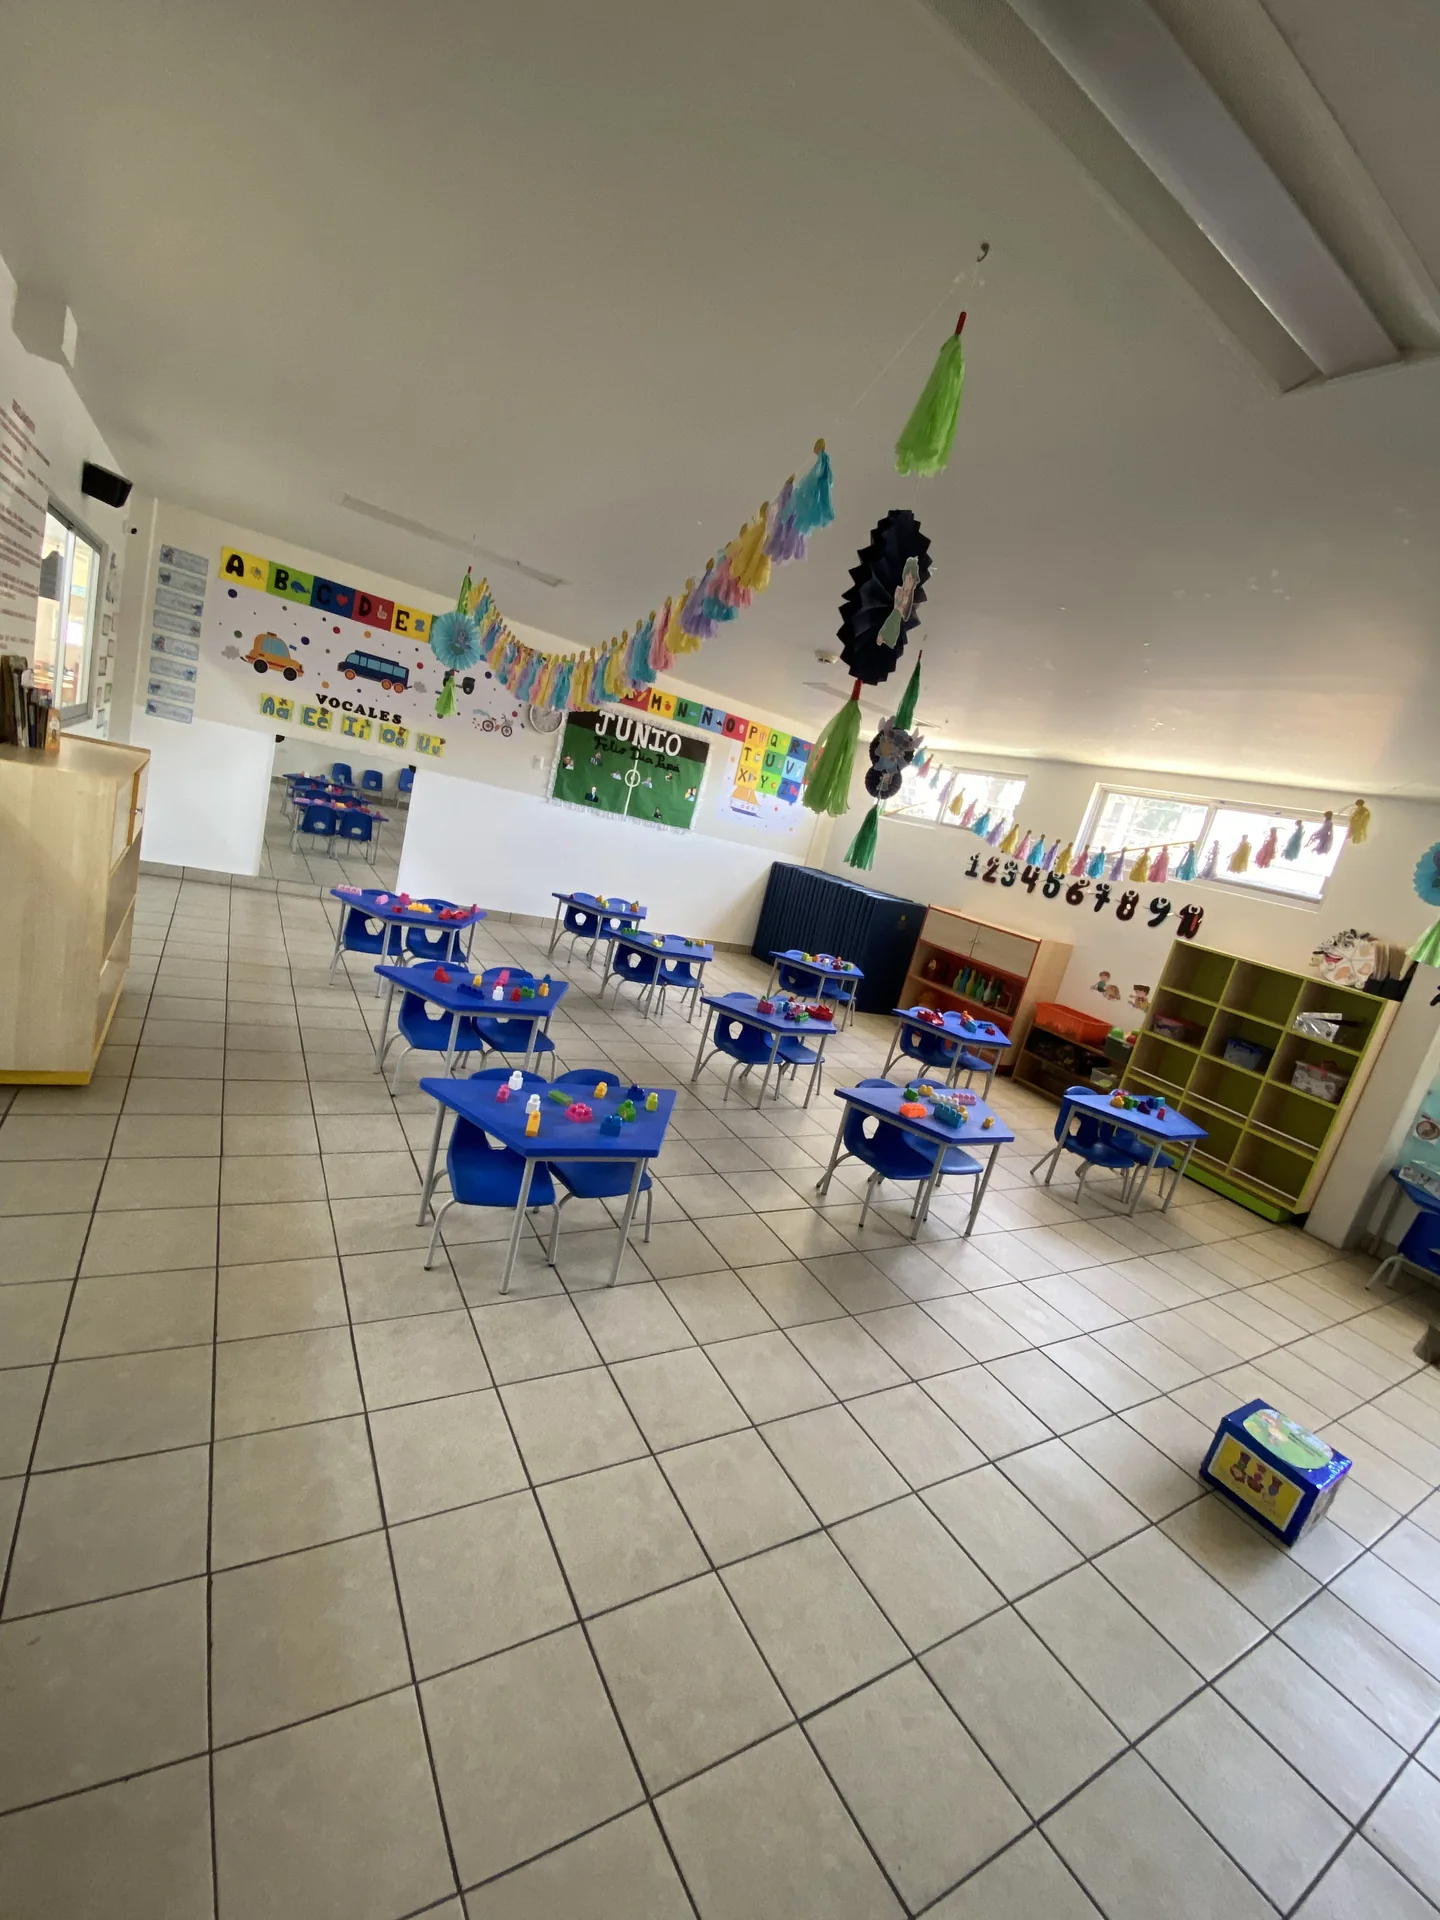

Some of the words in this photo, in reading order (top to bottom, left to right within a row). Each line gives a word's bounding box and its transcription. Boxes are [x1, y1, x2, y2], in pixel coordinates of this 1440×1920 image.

[226, 554, 244, 577] A
[275, 569, 289, 591] B
[317, 584, 332, 605] C
[359, 595, 372, 617] D
[395, 609, 410, 631] E
[263, 697, 289, 719] Aa
[304, 707, 328, 729] Ee
[344, 716, 364, 738] Ii
[316, 693, 402, 725] VOCALES
[651, 693, 662, 711] M
[677, 702, 688, 718] N
[702, 707, 713, 726] Ñ
[726, 718, 735, 733] O
[749, 726, 758, 739] P
[770, 734, 778, 747] Q
[790, 740, 800, 755] R
[595, 710, 682, 757] JUNIO
[738, 768, 748, 782] X
[761, 775, 769, 788] Y
[744, 747, 752, 761] T
[765, 753, 775, 767] U
[786, 760, 795, 774] V
